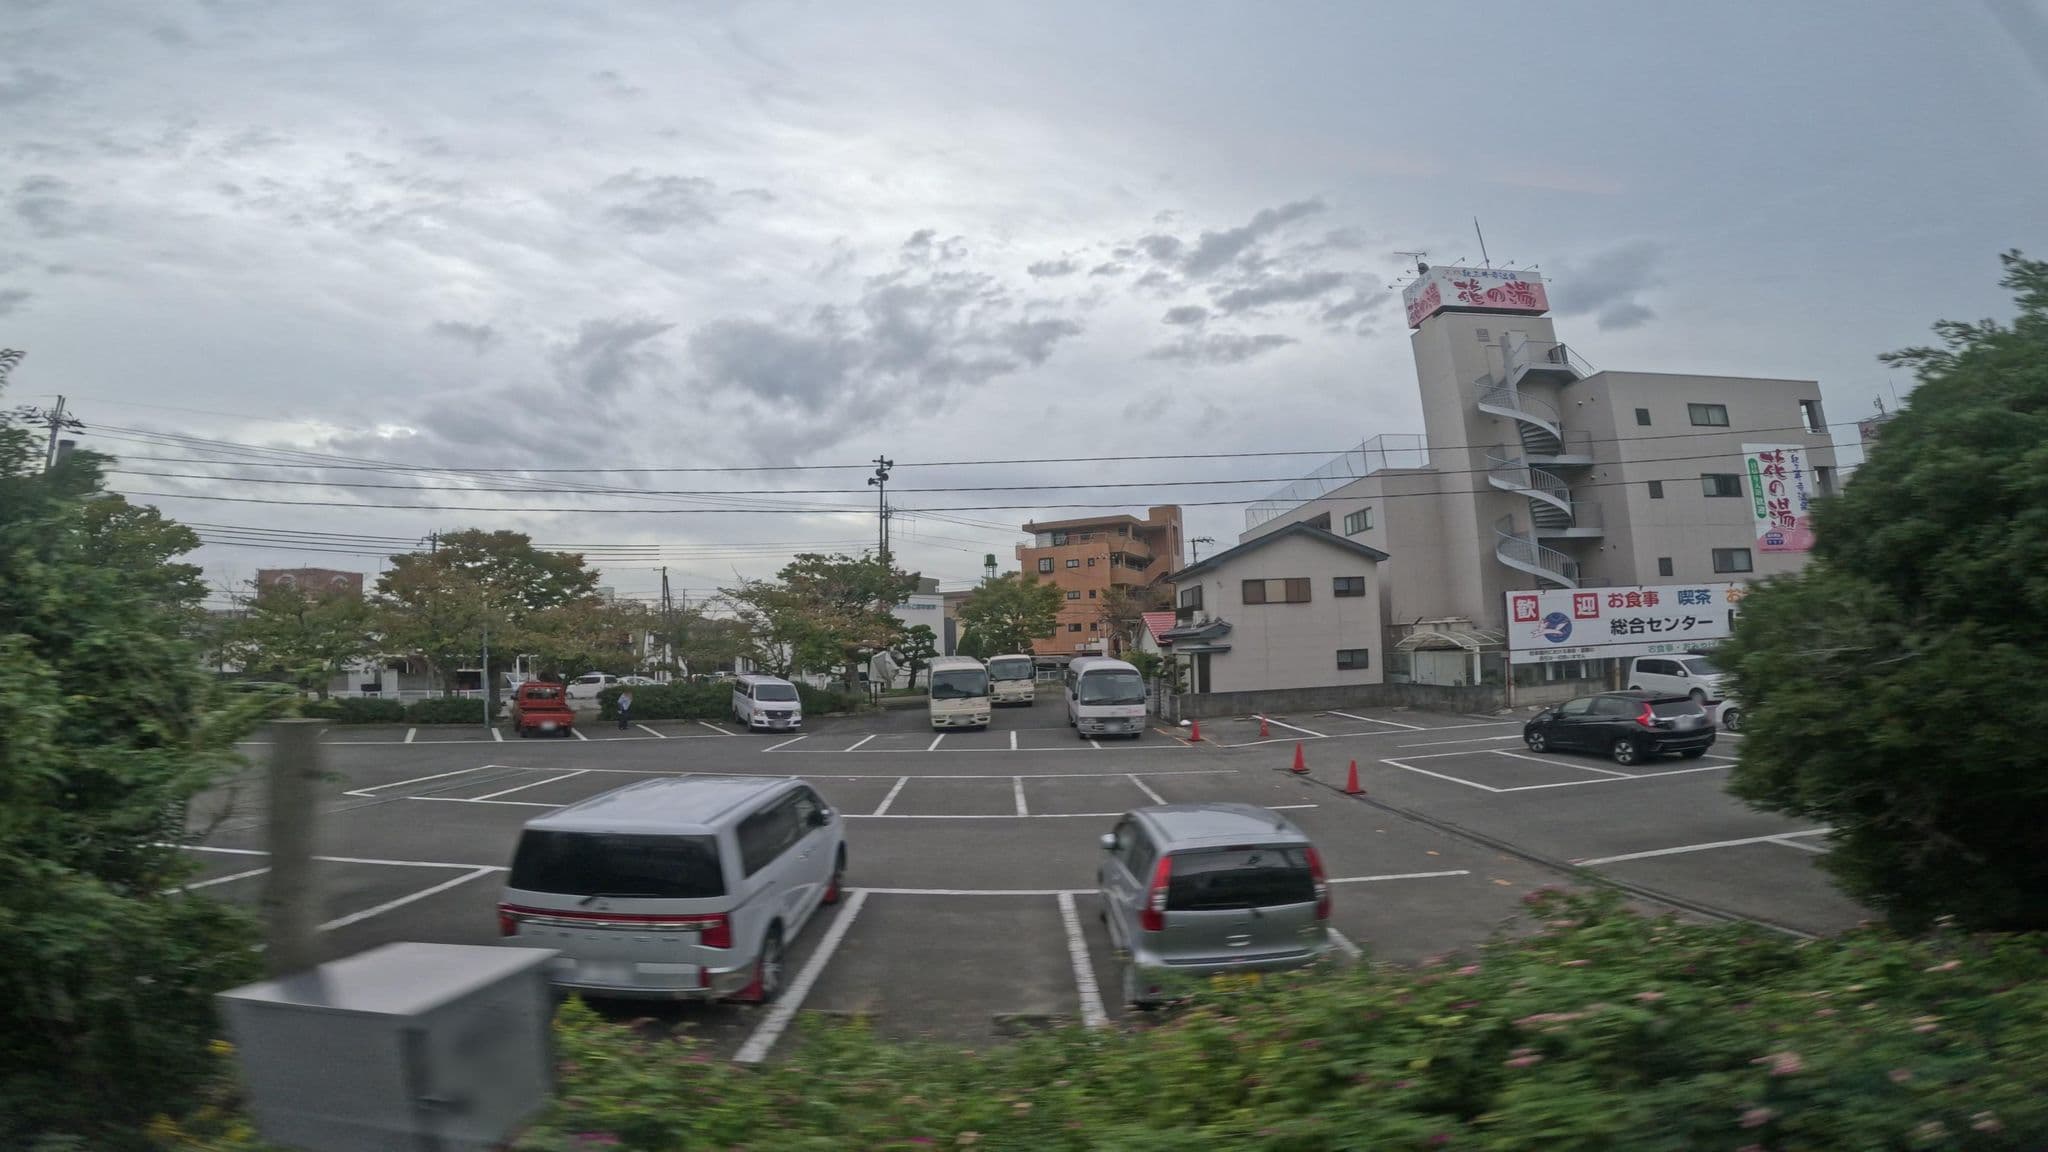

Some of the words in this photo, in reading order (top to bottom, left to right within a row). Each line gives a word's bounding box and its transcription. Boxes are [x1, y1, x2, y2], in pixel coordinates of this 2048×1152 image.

[1607, 590, 1660, 609] お食事
[1677, 588, 1712, 606] 喫茶
[1610, 615, 1714, 636] 総合センター
